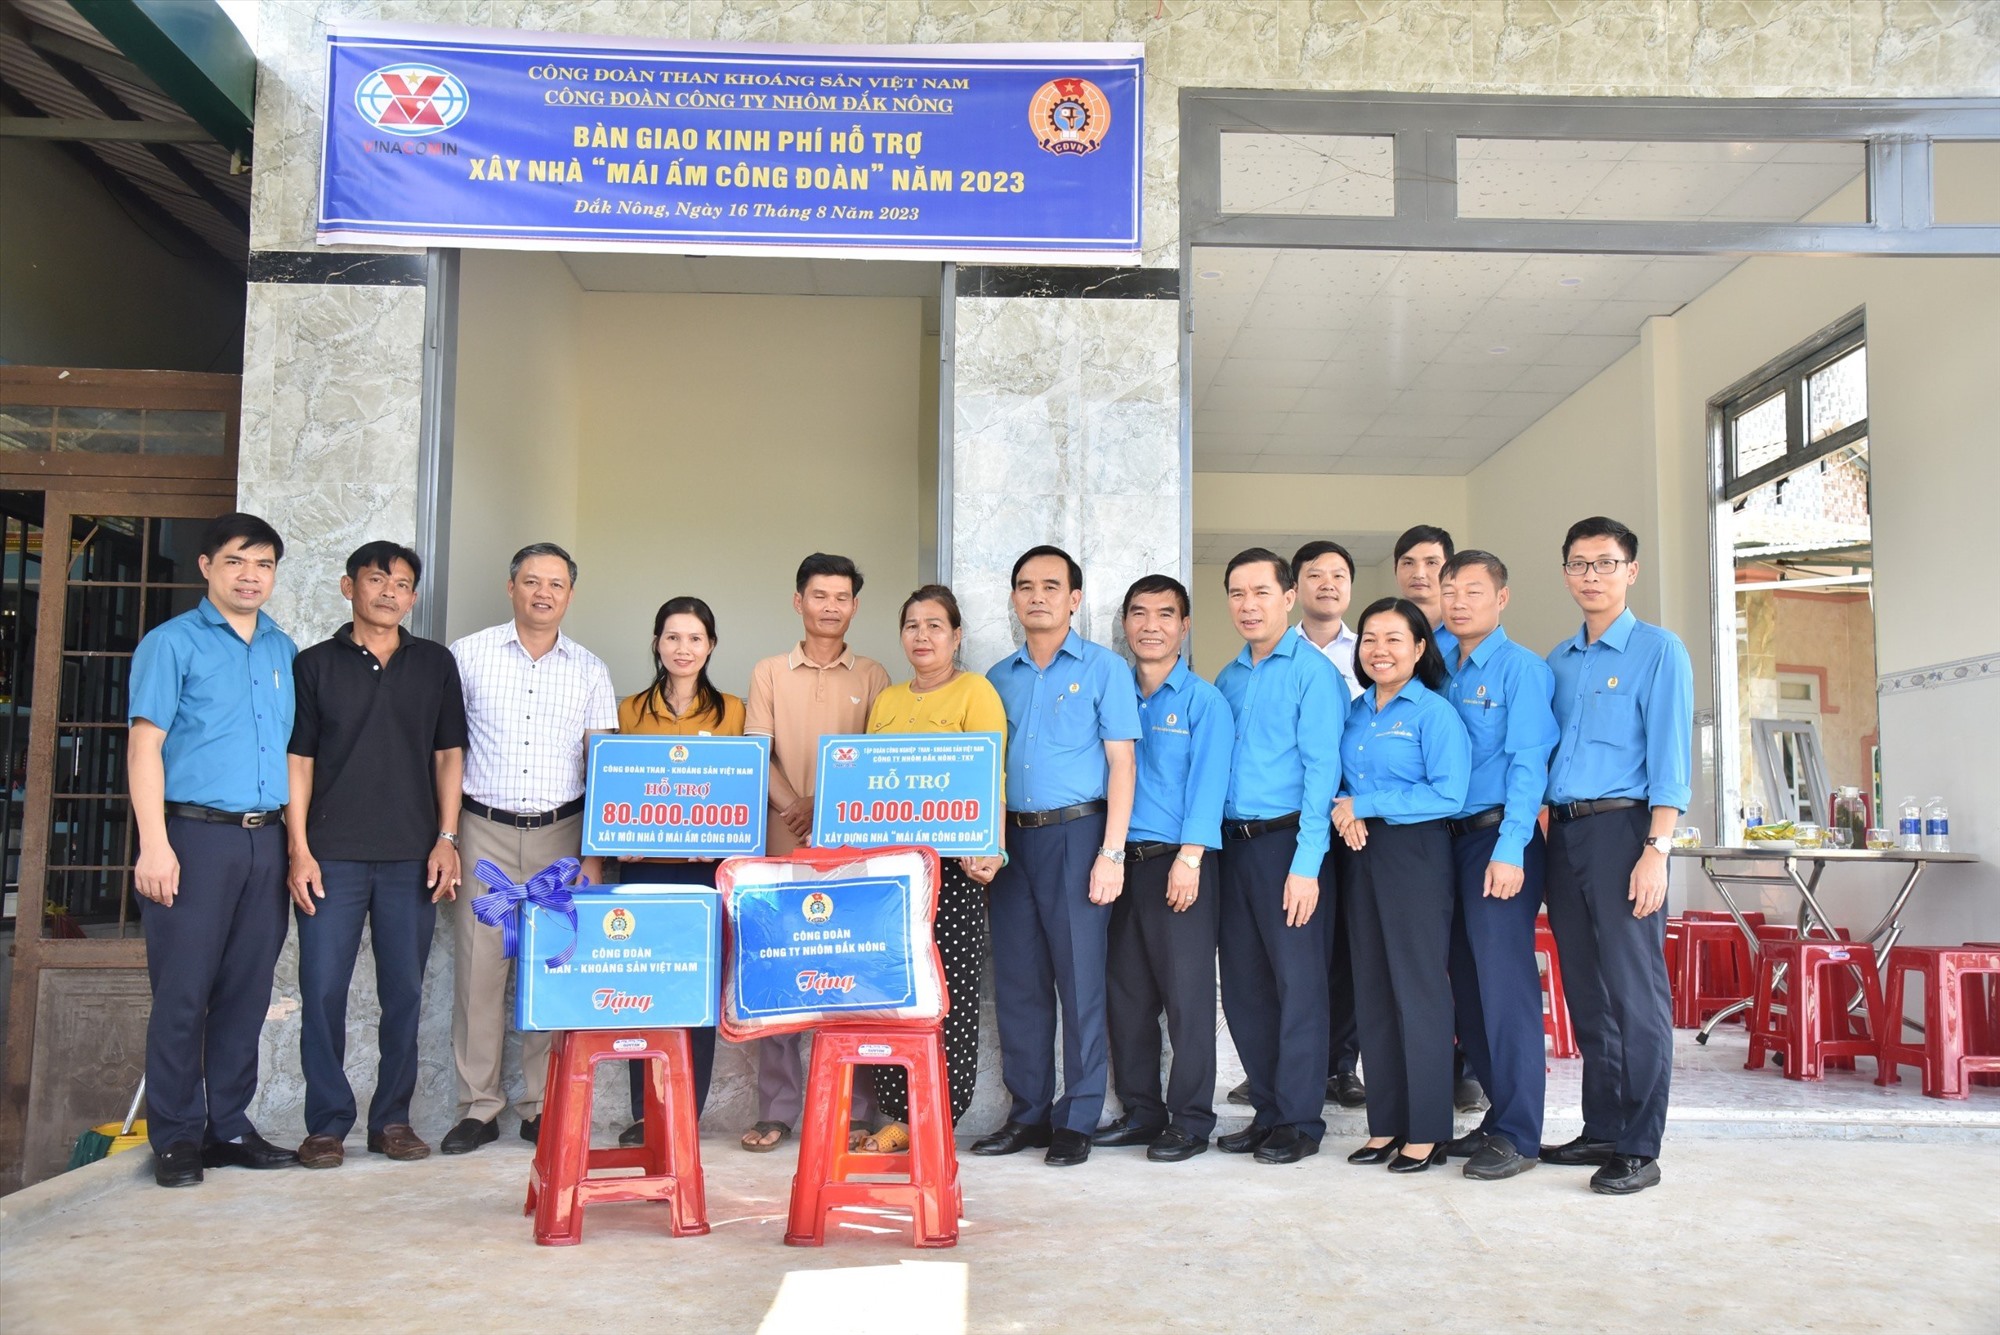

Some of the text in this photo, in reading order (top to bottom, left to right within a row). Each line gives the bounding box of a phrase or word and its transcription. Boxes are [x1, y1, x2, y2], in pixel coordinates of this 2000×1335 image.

[528, 63, 970, 92] CÔNG ĐOÀN THAN KHOÁNG SẢN VIỆT NAM
[545, 90, 954, 113] CÔNG ĐOÀN CÔNG TY NHÔM ĐẮK NÔNG
[363, 140, 458, 156] VINACOMIN
[574, 123, 922, 160] BÀN GIAO KINH PHÍ HỖ TRỢ
[469, 154, 1025, 193] XÂY NHÀ “MÁI ẤM CÔNG ĐOÀN” NĂM 2023
[573, 199, 920, 221] Đắk Nông, Ngày 16 Tháng 8 Năm 2023
[873, 755, 891, 763] CÔNG
[937, 754, 956, 762] NÔNG
[603, 765, 623, 773] CÔNG
[625, 765, 645, 773] ĐOÀN
[646, 766, 666, 774] THAN
[671, 766, 701, 775] KHOÁNG
[703, 766, 718, 775] SẢN
[719, 766, 735, 776] VIỆT
[868, 769, 950, 792] HỖ TRỢ
[646, 778, 711, 799] HỖ TRỢ
[602, 802, 749, 826] 80.000.000Đ
[836, 799, 980, 823] 10.000.000Đ
[598, 829, 751, 843] XÂY MỚI NHÀ Ở MÁI ẤM CÔNG ĐOÀN
[825, 829, 989, 844] XÂY DỰNG NHÀ “MÁI ẤM CÔNG ĐOÀN”
[793, 928, 851, 941] CÔNG ĐOÀN
[592, 947, 652, 958] CÔNG ĐOÀN
[760, 947, 786, 959] CÔNG
[789, 948, 800, 957] TY
[858, 941, 886, 953] NÔNG
[581, 962, 623, 973] KHOÁNG
[626, 961, 648, 973] SẢN
[650, 961, 671, 974] VIỆT
[674, 962, 698, 972] NAM
[795, 970, 856, 995] Tặng
[592, 988, 654, 1015] Tặng
